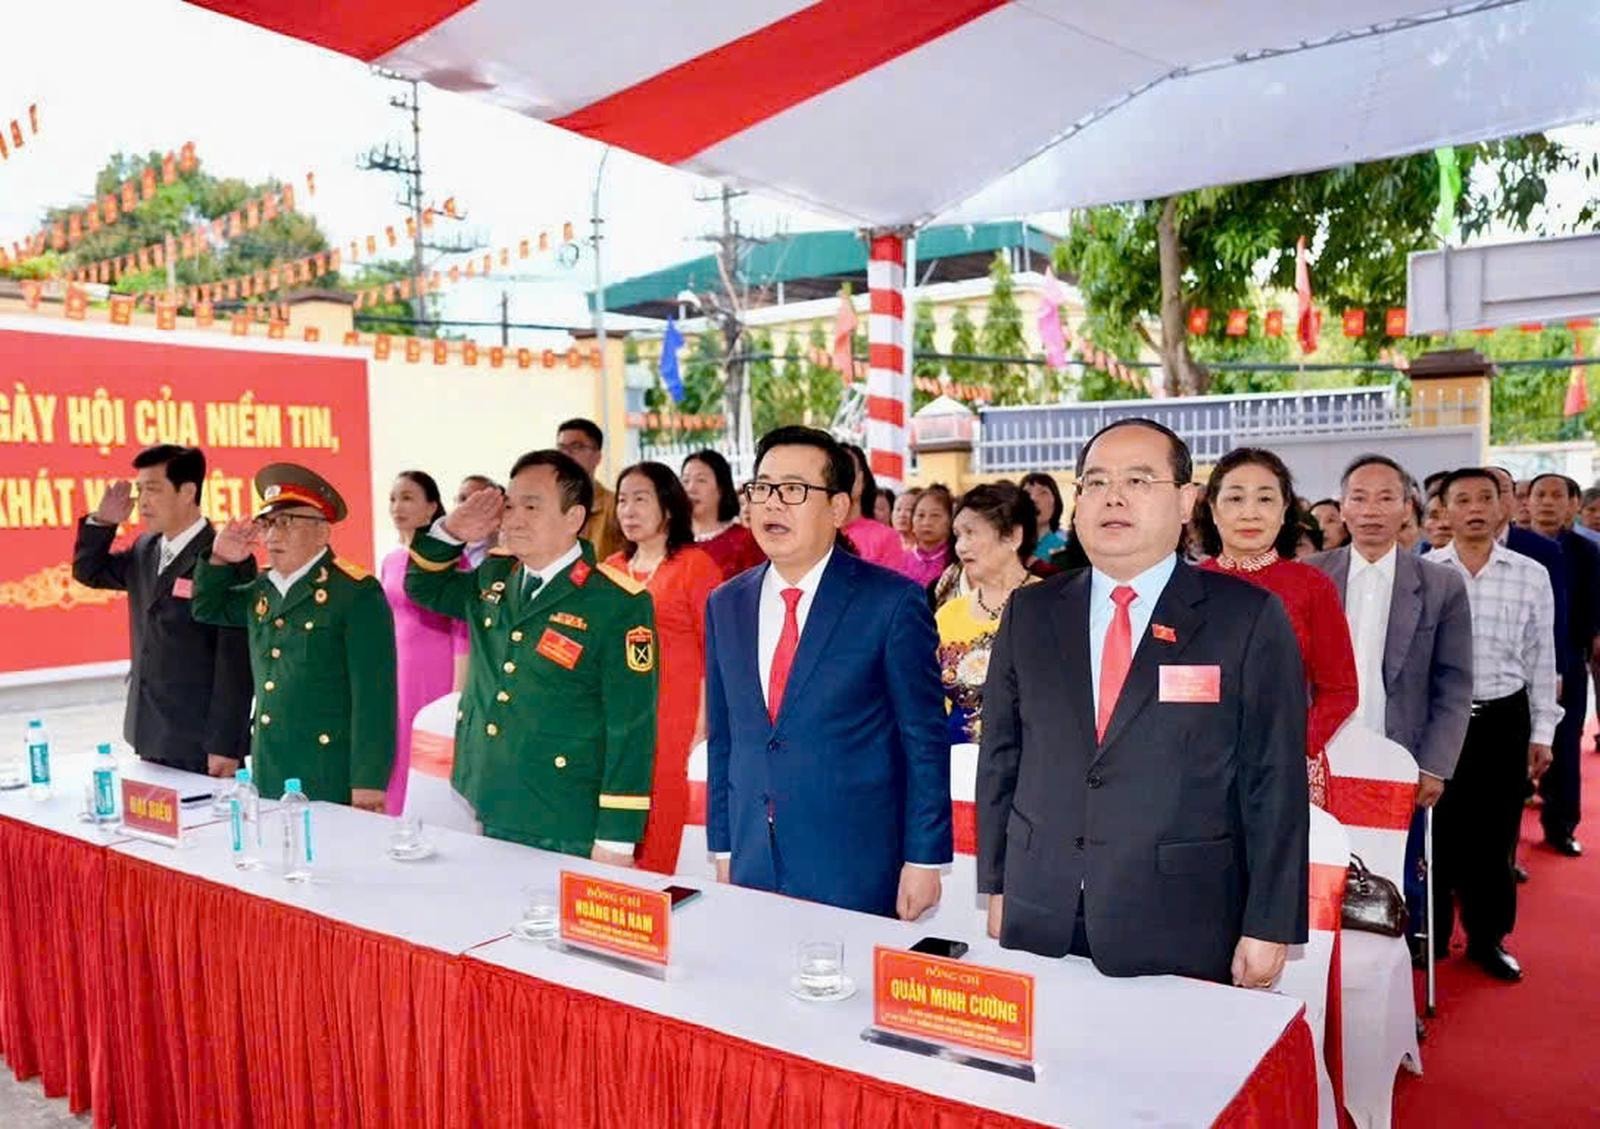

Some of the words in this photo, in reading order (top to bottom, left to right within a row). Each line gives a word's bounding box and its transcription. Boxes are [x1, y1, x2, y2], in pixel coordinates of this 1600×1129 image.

[67, 387, 127, 455] HỘI
[134, 384, 199, 447] CỦA
[205, 389, 282, 449] NIỀM
[286, 404, 340, 455] TIN,
[890, 976, 928, 1005] QUẢN
[929, 986, 967, 1013] MINH
[969, 992, 1019, 1024] CƯỜNG
